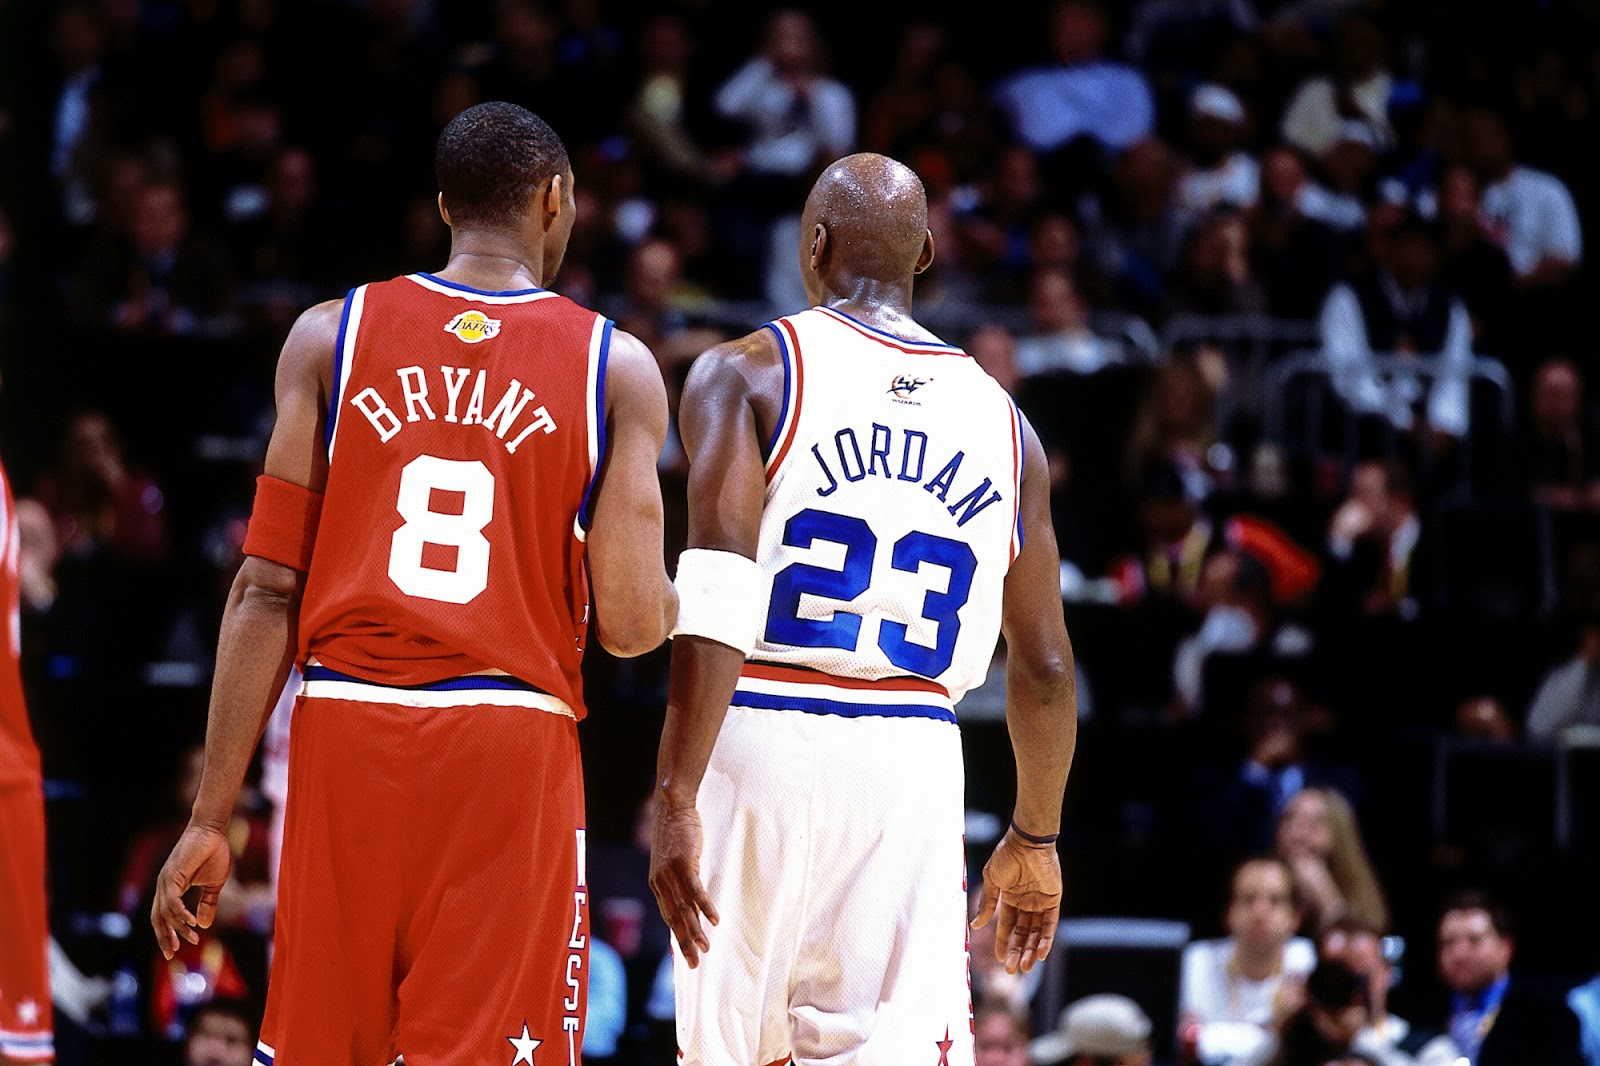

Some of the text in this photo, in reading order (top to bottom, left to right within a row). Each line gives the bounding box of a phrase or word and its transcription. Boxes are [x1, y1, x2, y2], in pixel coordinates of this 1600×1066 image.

[350, 365, 558, 455] BRYANT
[891, 398, 922, 407] WIZARDS
[811, 422, 1002, 528] JORDAN
[387, 453, 496, 605] 8
[764, 507, 978, 679] 23
